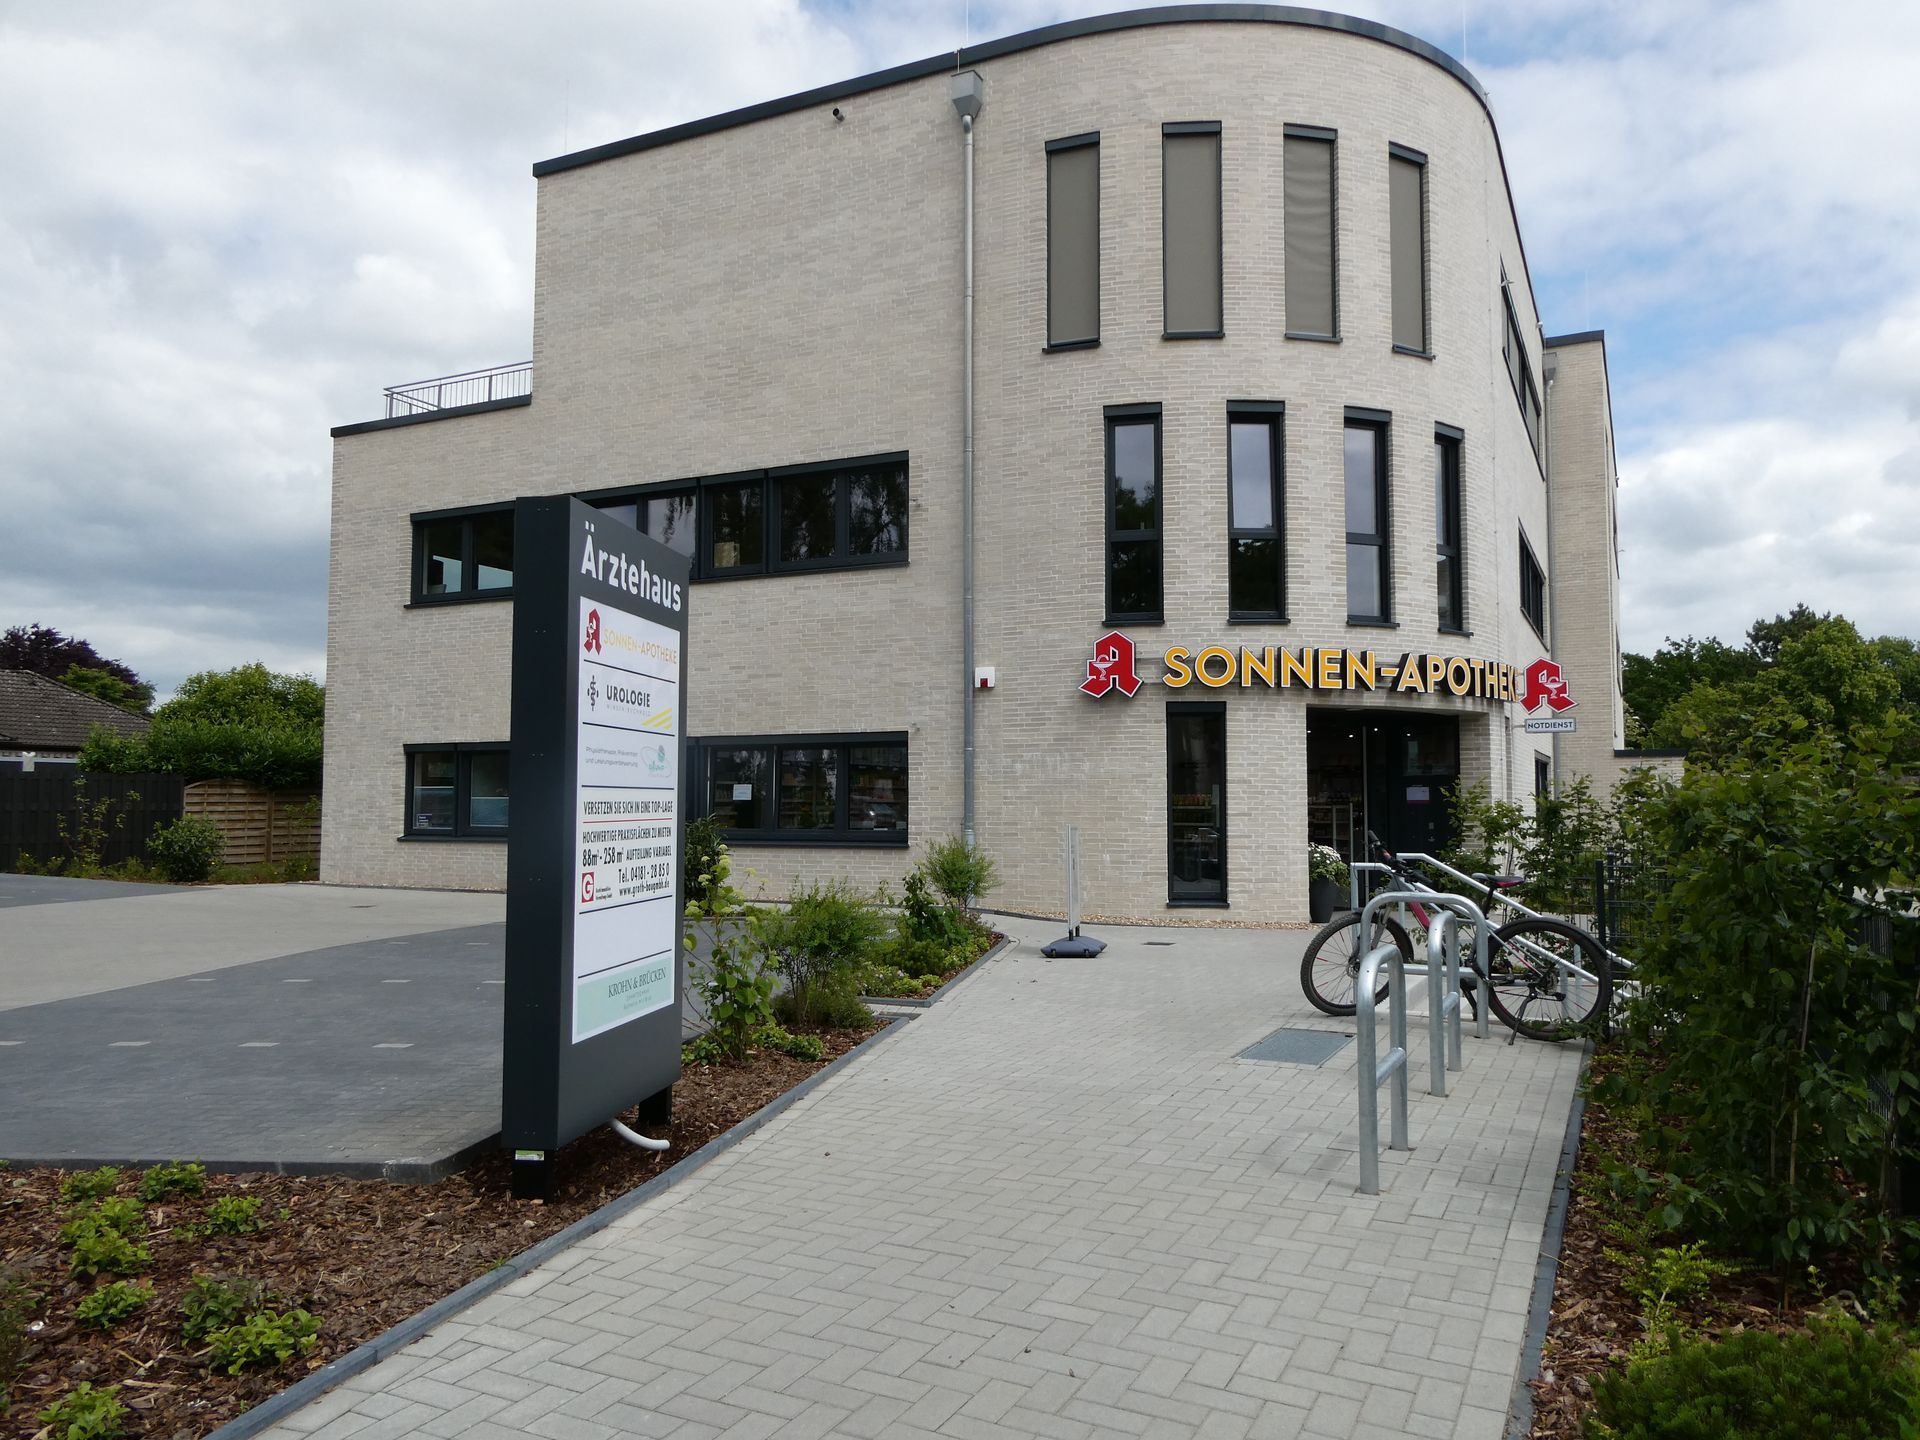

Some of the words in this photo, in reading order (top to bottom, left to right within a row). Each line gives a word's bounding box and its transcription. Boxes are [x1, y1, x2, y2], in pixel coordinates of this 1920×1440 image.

[581, 521, 681, 612] Ärztehaus
[603, 627, 678, 665] SONNEN-APOTHEKE
[1162, 645, 1520, 702] SONNEN-APOTHEK
[606, 684, 651, 707] UROLOGIE
[1527, 721, 1573, 730] NOTDIENST
[583, 801, 613, 815] VERSETZEN
[614, 801, 622, 814] SIE
[622, 801, 633, 814] SICH
[634, 801, 640, 813] IN
[640, 801, 651, 813] EINE
[651, 801, 673, 813] TOP-LAGE
[582, 829, 617, 844] HOCHWERTIGE
[651, 827, 657, 838] ZU
[657, 827, 672, 838] MIETEN
[603, 846, 616, 865] 258
[626, 847, 652, 861] AUFTEILUNG
[653, 845, 672, 858] VARIABEL
[618, 867, 629, 884] Tel.
